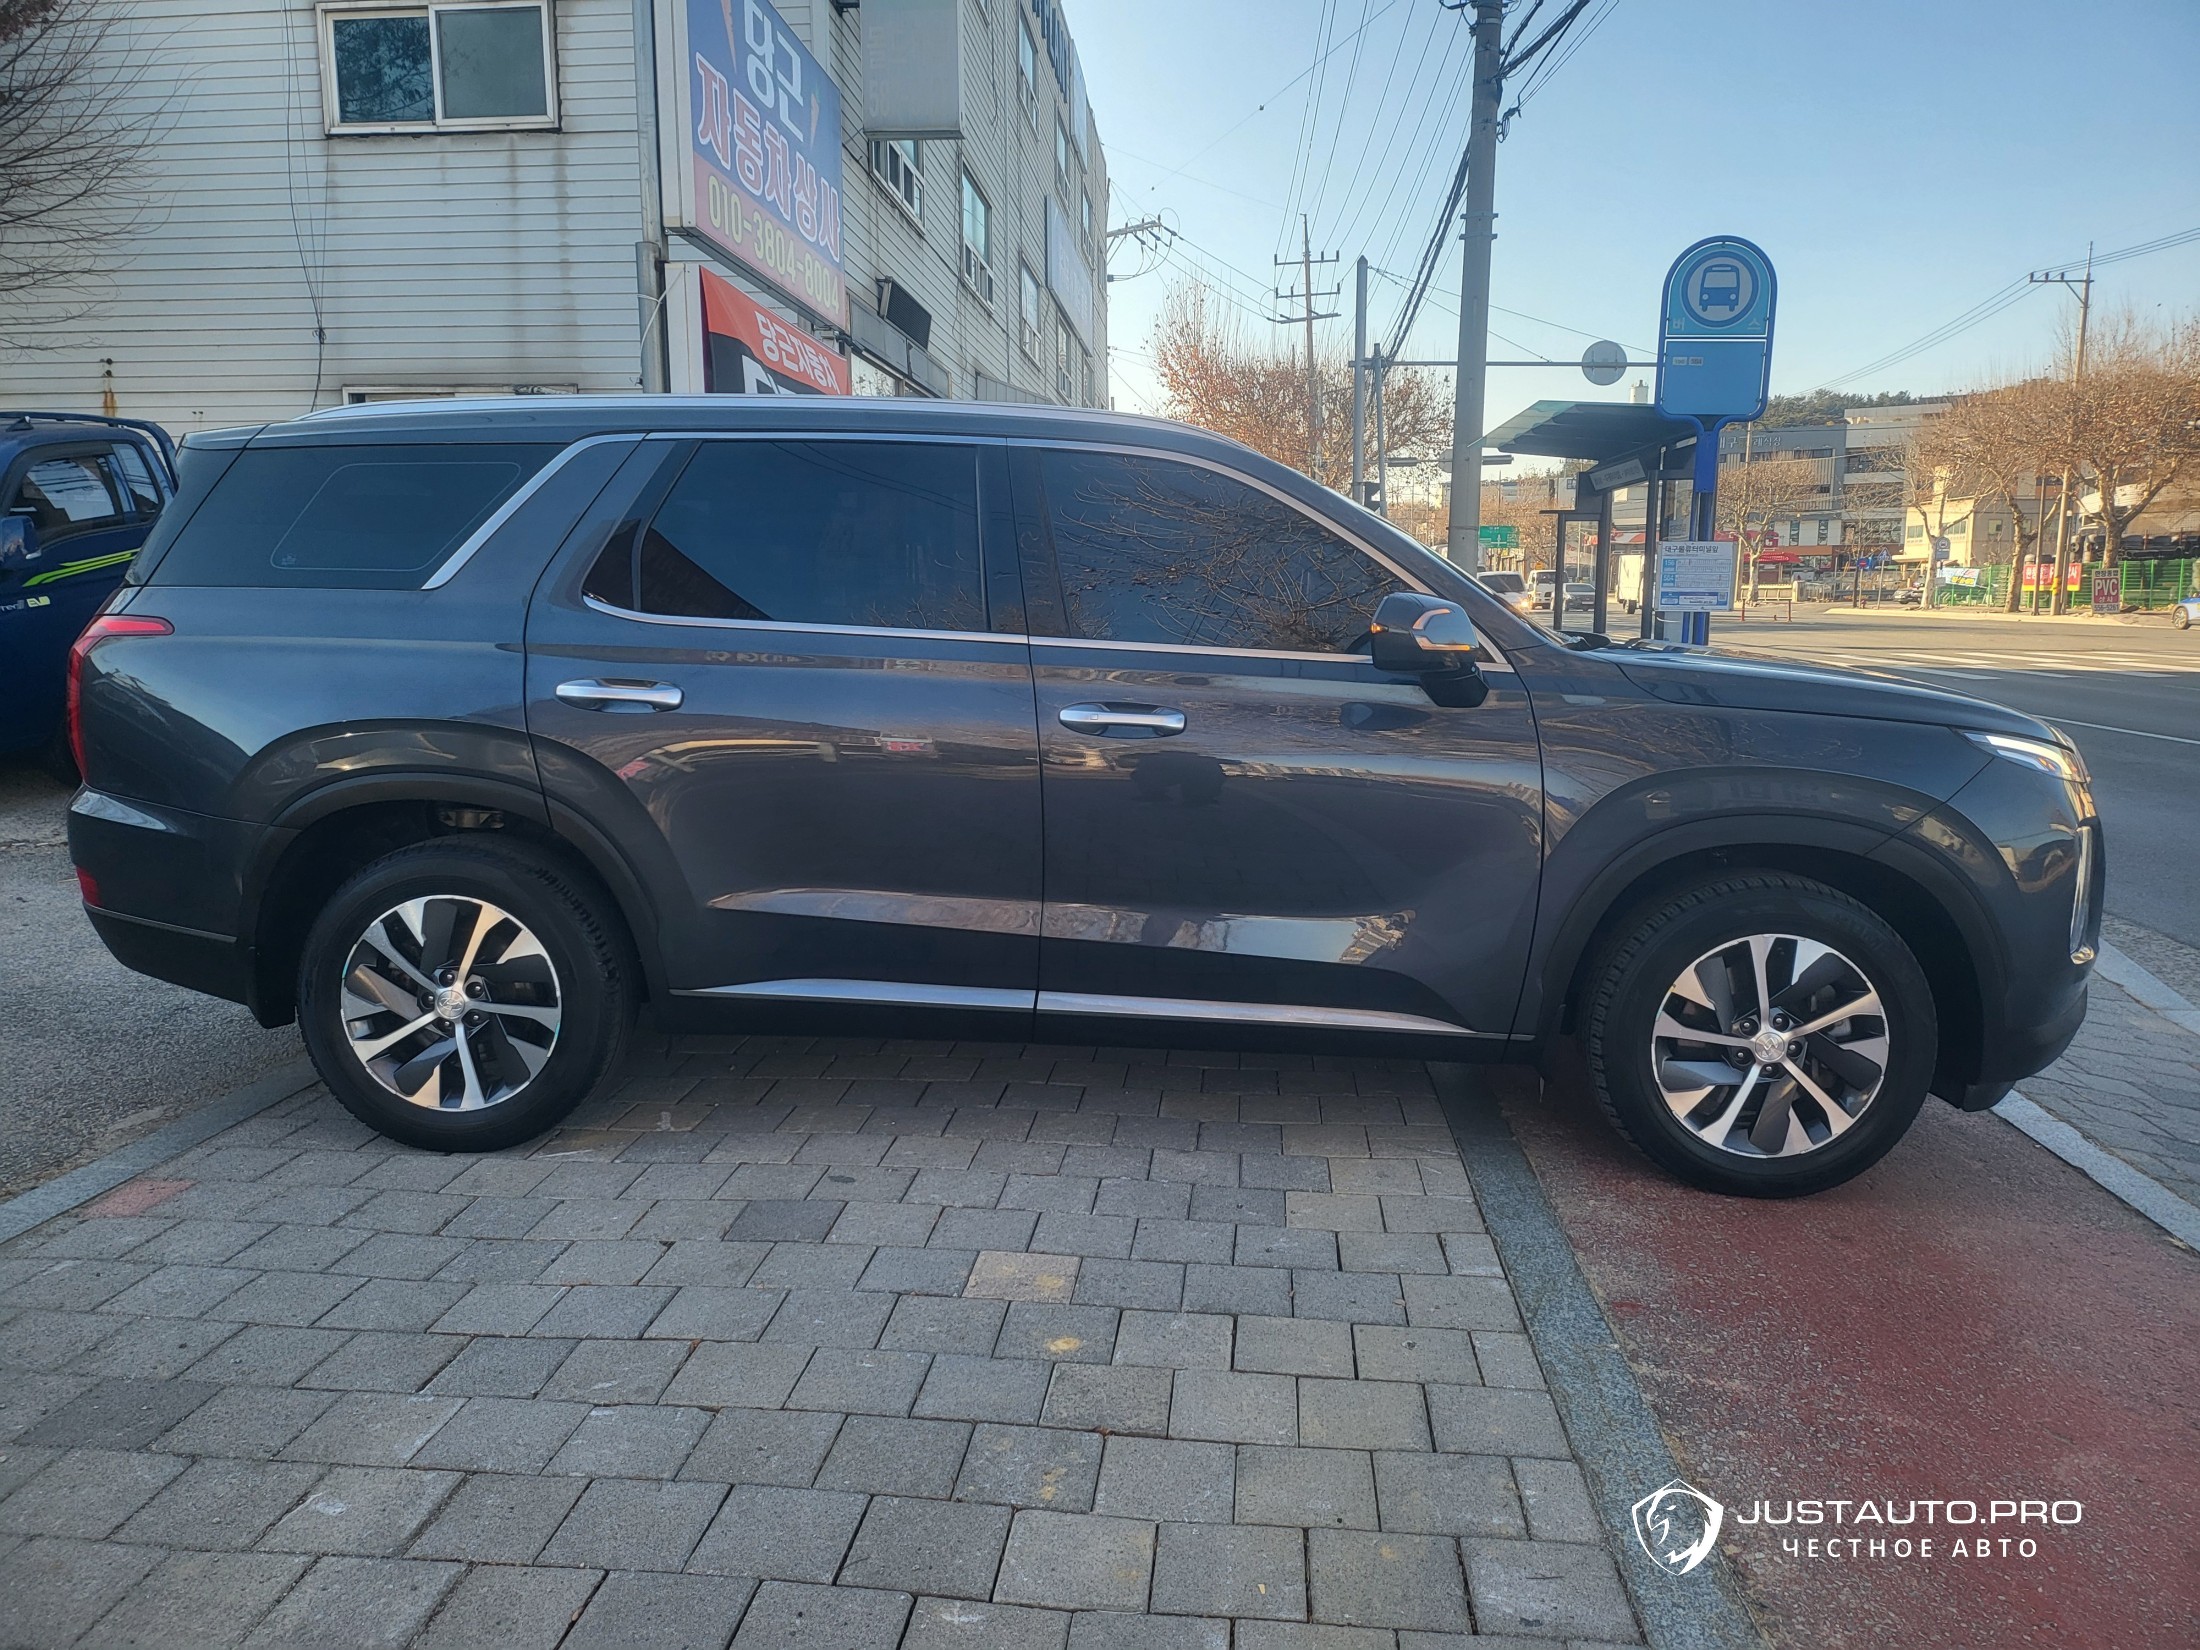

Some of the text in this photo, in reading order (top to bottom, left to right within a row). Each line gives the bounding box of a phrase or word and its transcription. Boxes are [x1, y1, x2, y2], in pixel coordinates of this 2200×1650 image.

[744, 0, 803, 142] 당근
[695, 51, 841, 264] 자동차상사
[708, 175, 840, 314] 010-3804-8004
[754, 310, 841, 395] 당근자동차
[1664, 545, 1719, 554] 대구물류터미널앞
[2095, 579, 2117, 596] PVC
